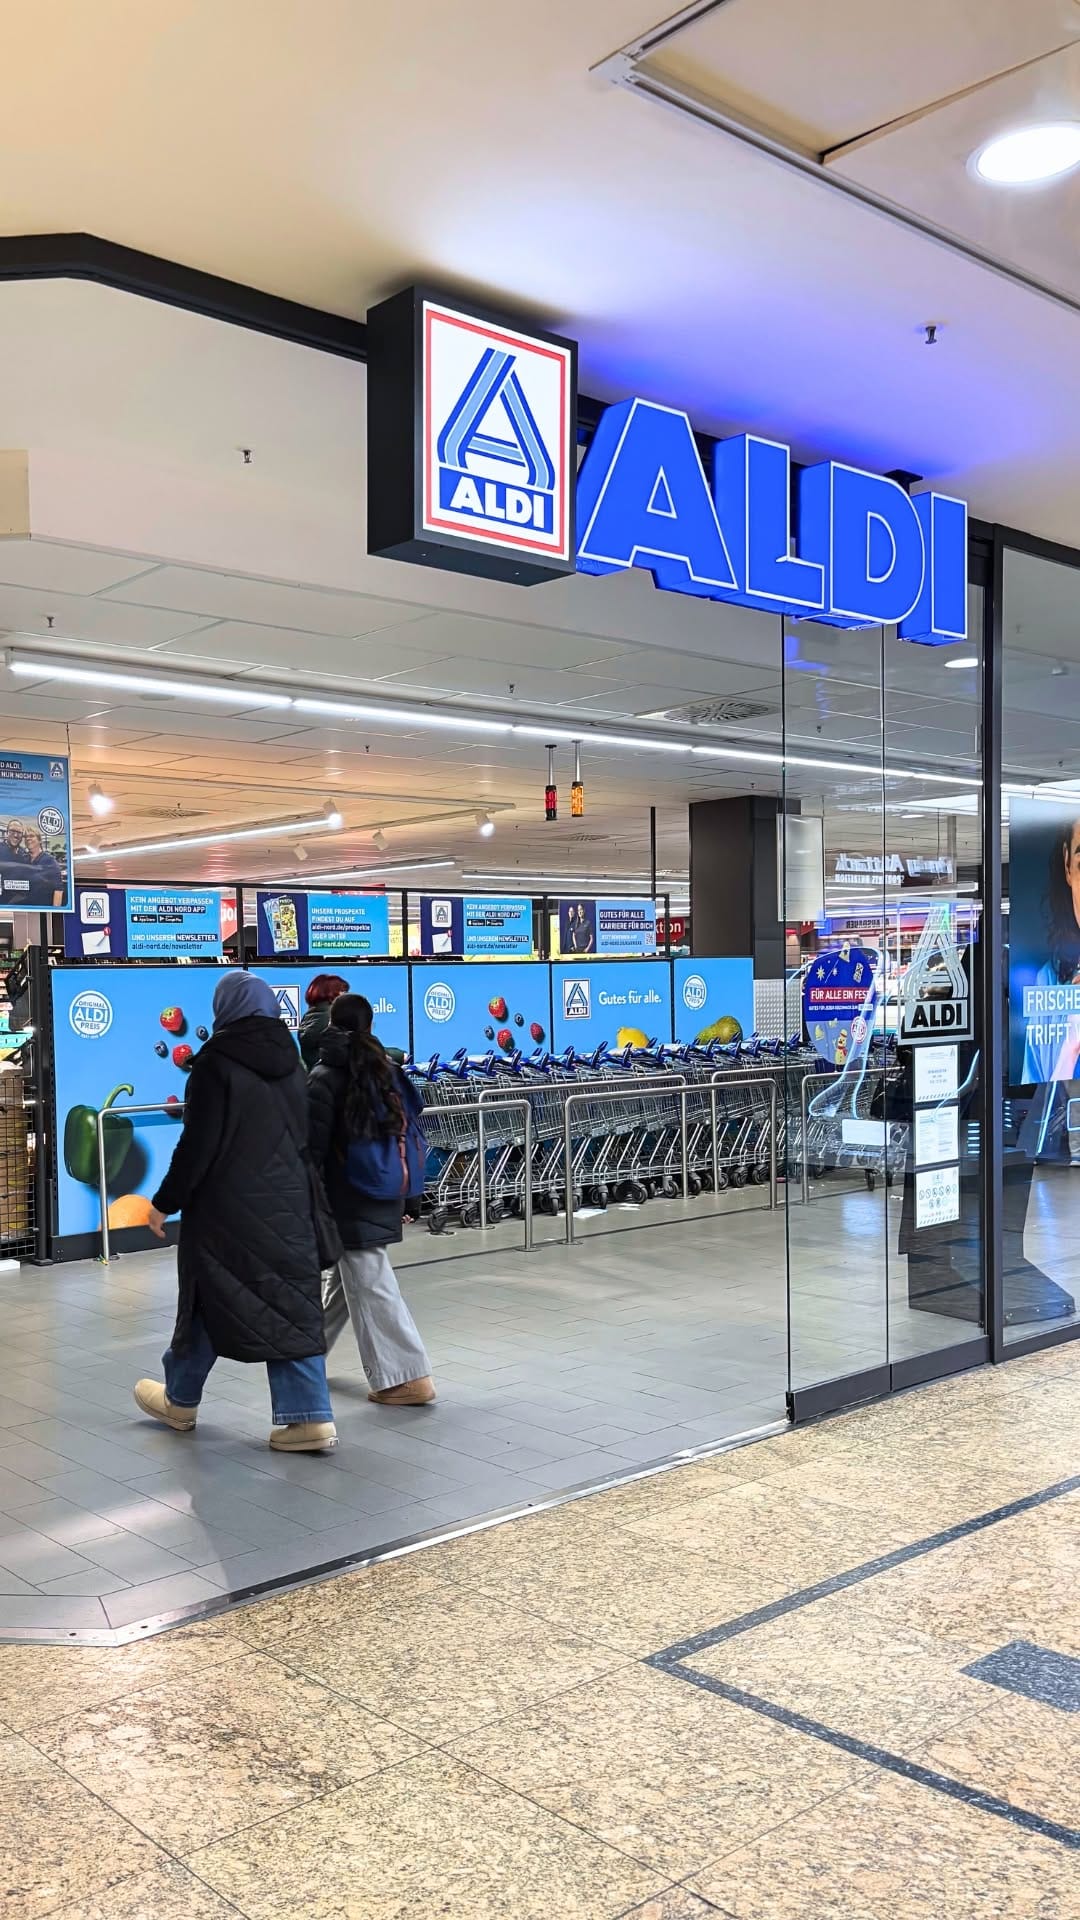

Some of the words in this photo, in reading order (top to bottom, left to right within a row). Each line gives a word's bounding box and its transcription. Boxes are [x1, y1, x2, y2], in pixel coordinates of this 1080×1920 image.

[449, 475, 545, 529] ALDI
[577, 397, 968, 640] ALDI
[130, 896, 147, 904] KEIN
[178, 897, 214, 905] VERPASSEN
[158, 905, 174, 913] ALDI
[599, 911, 618, 919] GUTES
[618, 910, 630, 919] FÜR
[311, 915, 335, 923] FINDEST
[600, 922, 627, 930] KARRIERE
[627, 921, 640, 930] FÜR
[640, 922, 654, 930] DICH
[598, 991, 627, 1005] Gutes
[628, 990, 642, 1004] für
[643, 989, 662, 1004] alle.
[686, 987, 705, 999] ALDI
[811, 988, 825, 1000] FÜR
[825, 989, 842, 1000] ALLE
[842, 989, 854, 1000] EIN
[372, 998, 397, 1013] alle.
[427, 996, 452, 1010] ALDI
[74, 1007, 108, 1023] ALDI
[568, 1007, 587, 1015] ALDI
[910, 1002, 962, 1029] ALDI
[80, 1022, 101, 1030] PREIS
[1026, 1023, 1072, 1047] TRIFFT
